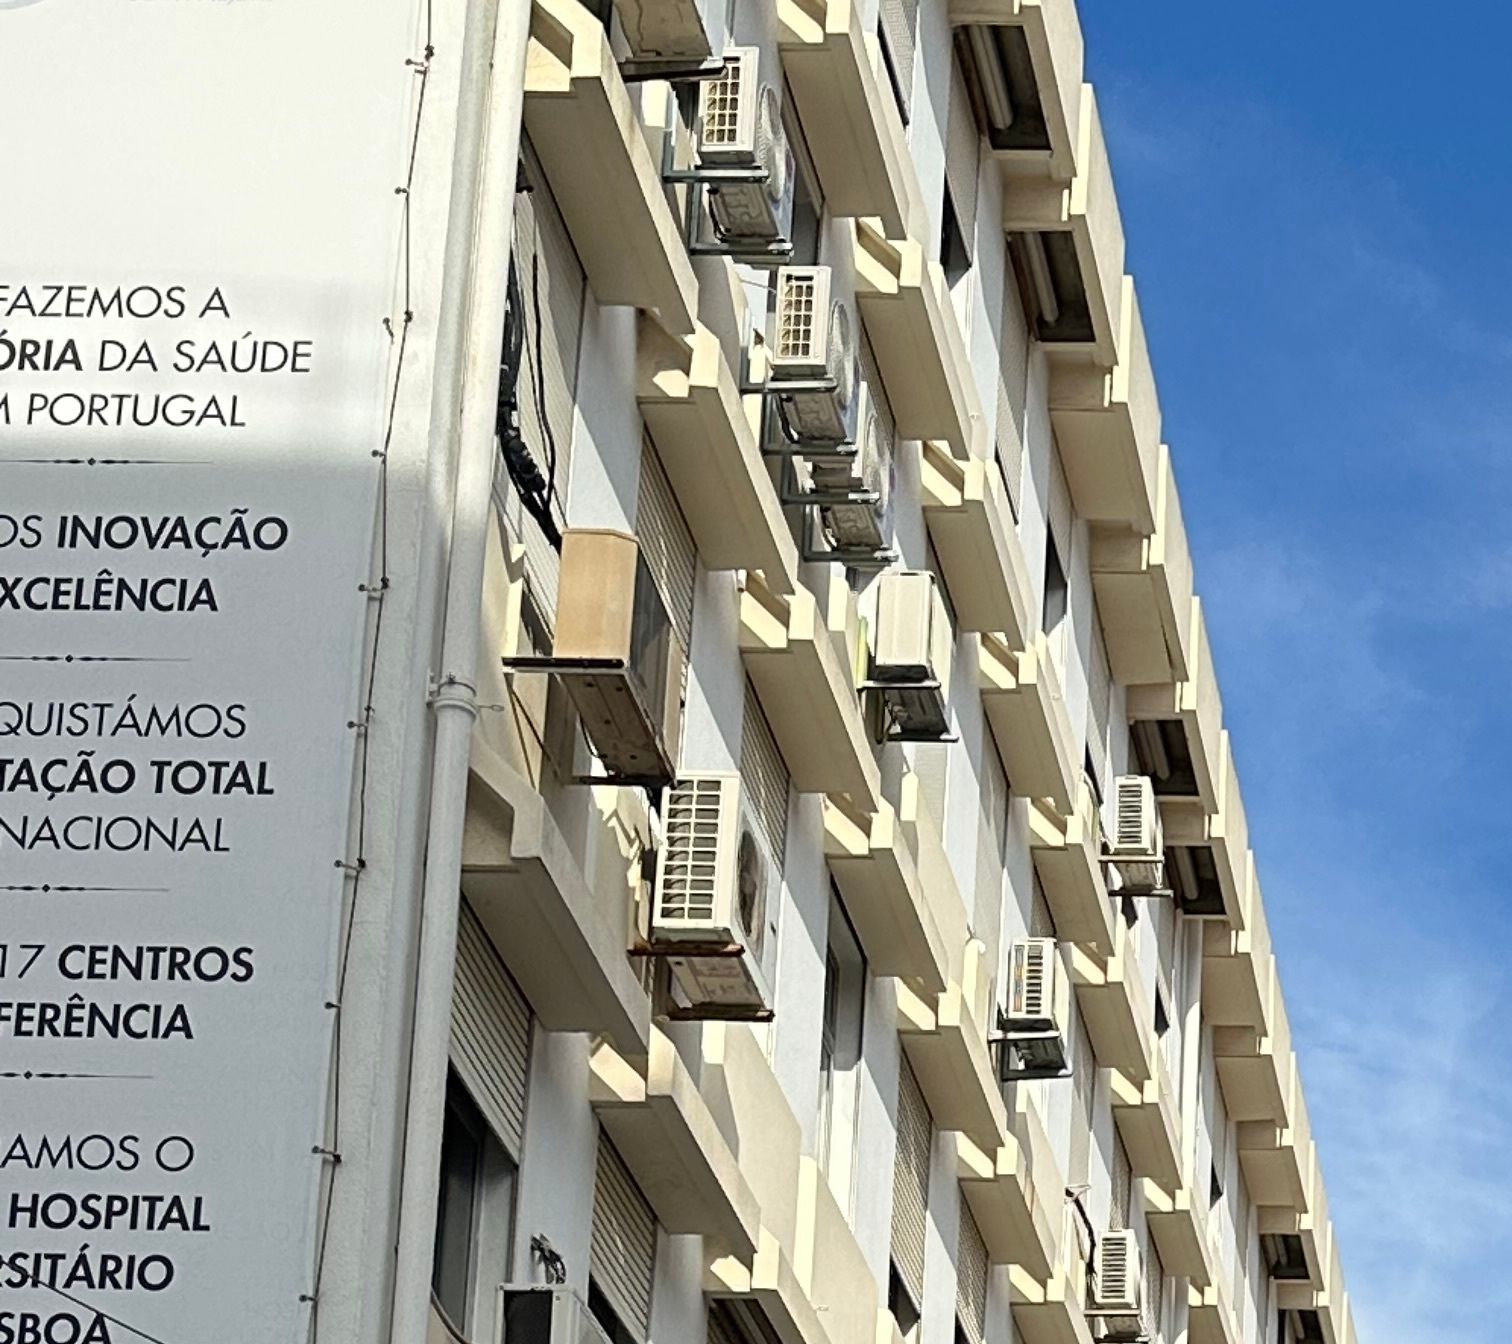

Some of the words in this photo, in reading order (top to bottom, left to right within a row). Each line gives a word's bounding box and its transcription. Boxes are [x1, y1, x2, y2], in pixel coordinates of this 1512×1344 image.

[198, 287, 231, 318] A
[98, 340, 158, 372] DA
[172, 331, 314, 374] SAÚDE
[26, 393, 247, 427] PORTUGAL
[57, 507, 289, 558] INOVAÇÃO
[0, 567, 219, 613] XCELÊNCIA
[0, 693, 248, 739] QUISTÁMOS
[0, 750, 137, 801] TAÇÃO
[150, 759, 275, 796] TOTAL
[0, 815, 231, 852] NACIONAL
[0, 944, 46, 980] 17
[57, 945, 254, 983] CENTROS
[0, 1133, 140, 1171] AMOS
[155, 1135, 195, 1172] O
[8, 1192, 211, 1232] HOSPITAL
[0, 1242, 175, 1292] SITÁRIO
